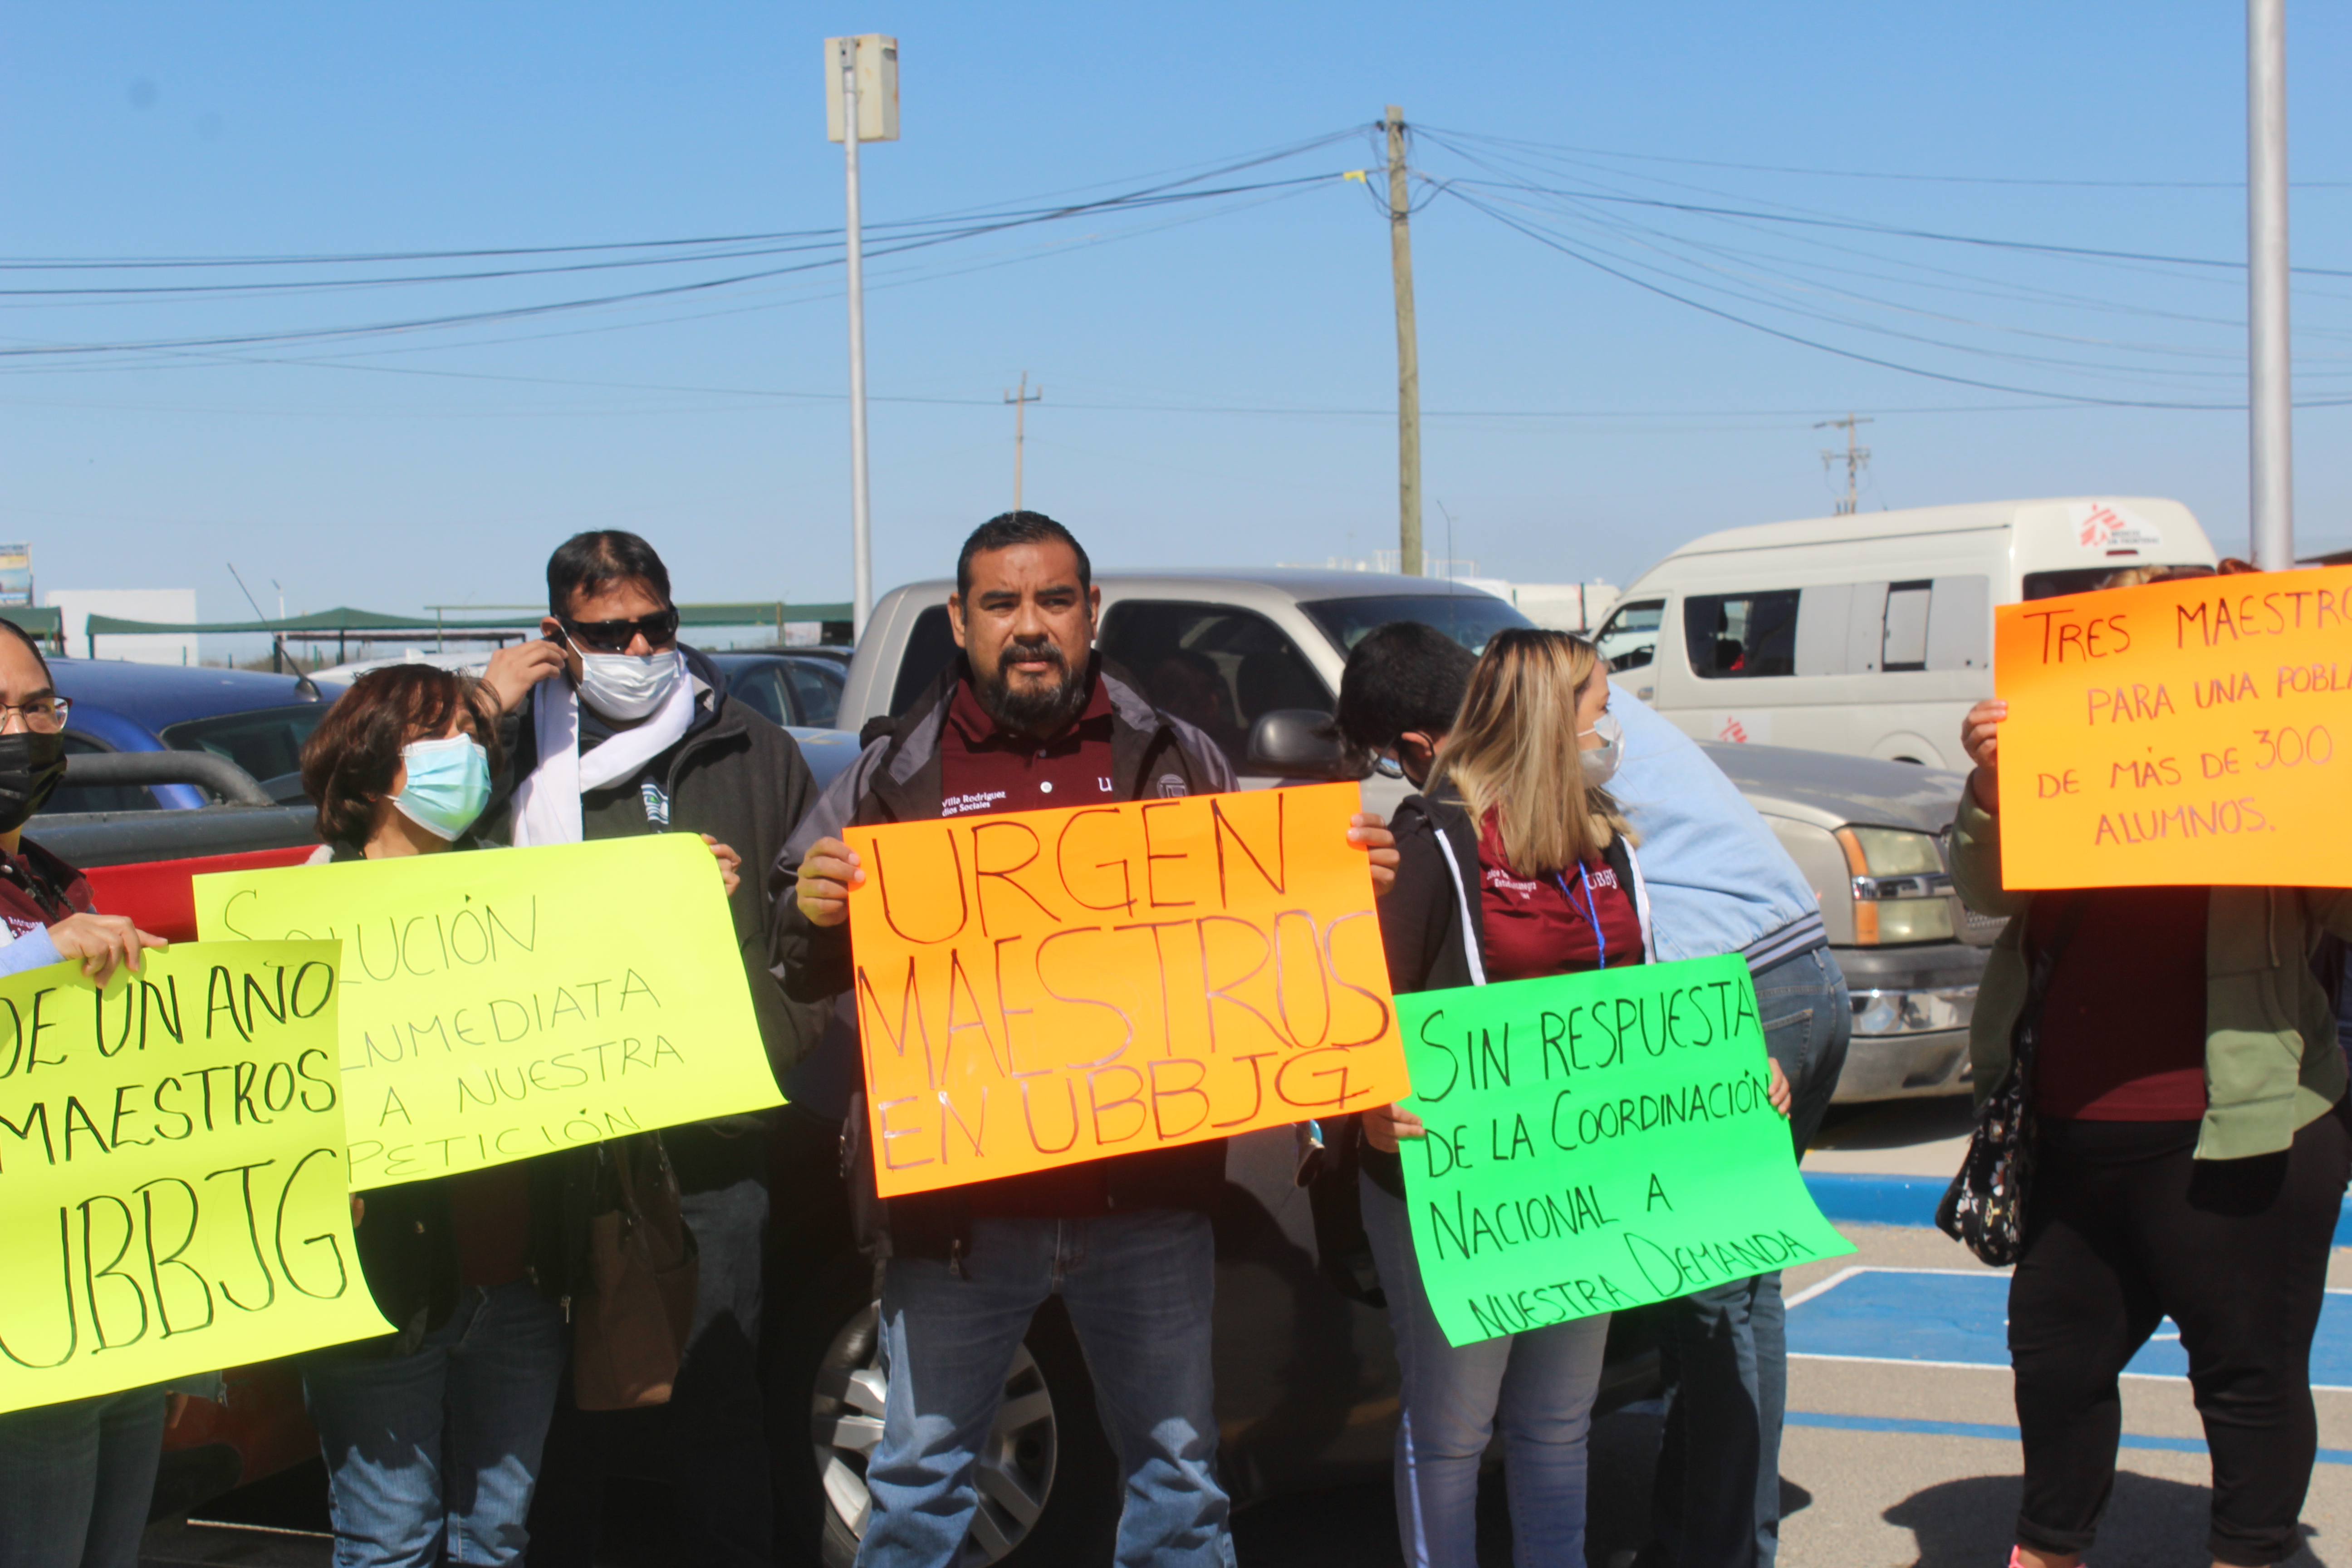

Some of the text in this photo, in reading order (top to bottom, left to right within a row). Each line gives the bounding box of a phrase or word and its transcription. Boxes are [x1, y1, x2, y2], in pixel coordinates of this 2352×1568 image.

[2023, 608, 2130, 664] TRES
[2087, 661, 2352, 725] PARA UNA POBL
[959, 801, 991, 812] Sociales
[2038, 725, 2333, 799] DE MÁS DE 300
[2094, 796, 2276, 845] ALUMNOS.
[872, 792, 1284, 944] URGEN
[1585, 868, 1617, 890] UBBJ
[96, 975, 184, 1057] UN
[340, 968, 661, 1071] NMEDIATA
[857, 910, 1389, 1094] MAESTROS
[1417, 977, 1760, 1102] SIN RESPUESTA
[0, 1049, 336, 1174] MAESTROS
[379, 1035, 684, 1126] A NUESTRA
[878, 1047, 1374, 1172] EN UBBJG
[1423, 1070, 1773, 1178] DE LA COORDINACIÓN
[347, 1106, 641, 1183] PETICIÓN
[1429, 1173, 1673, 1260] NACIONAL A
[1468, 1230, 1816, 1338] NUESTRA DEMANDA
